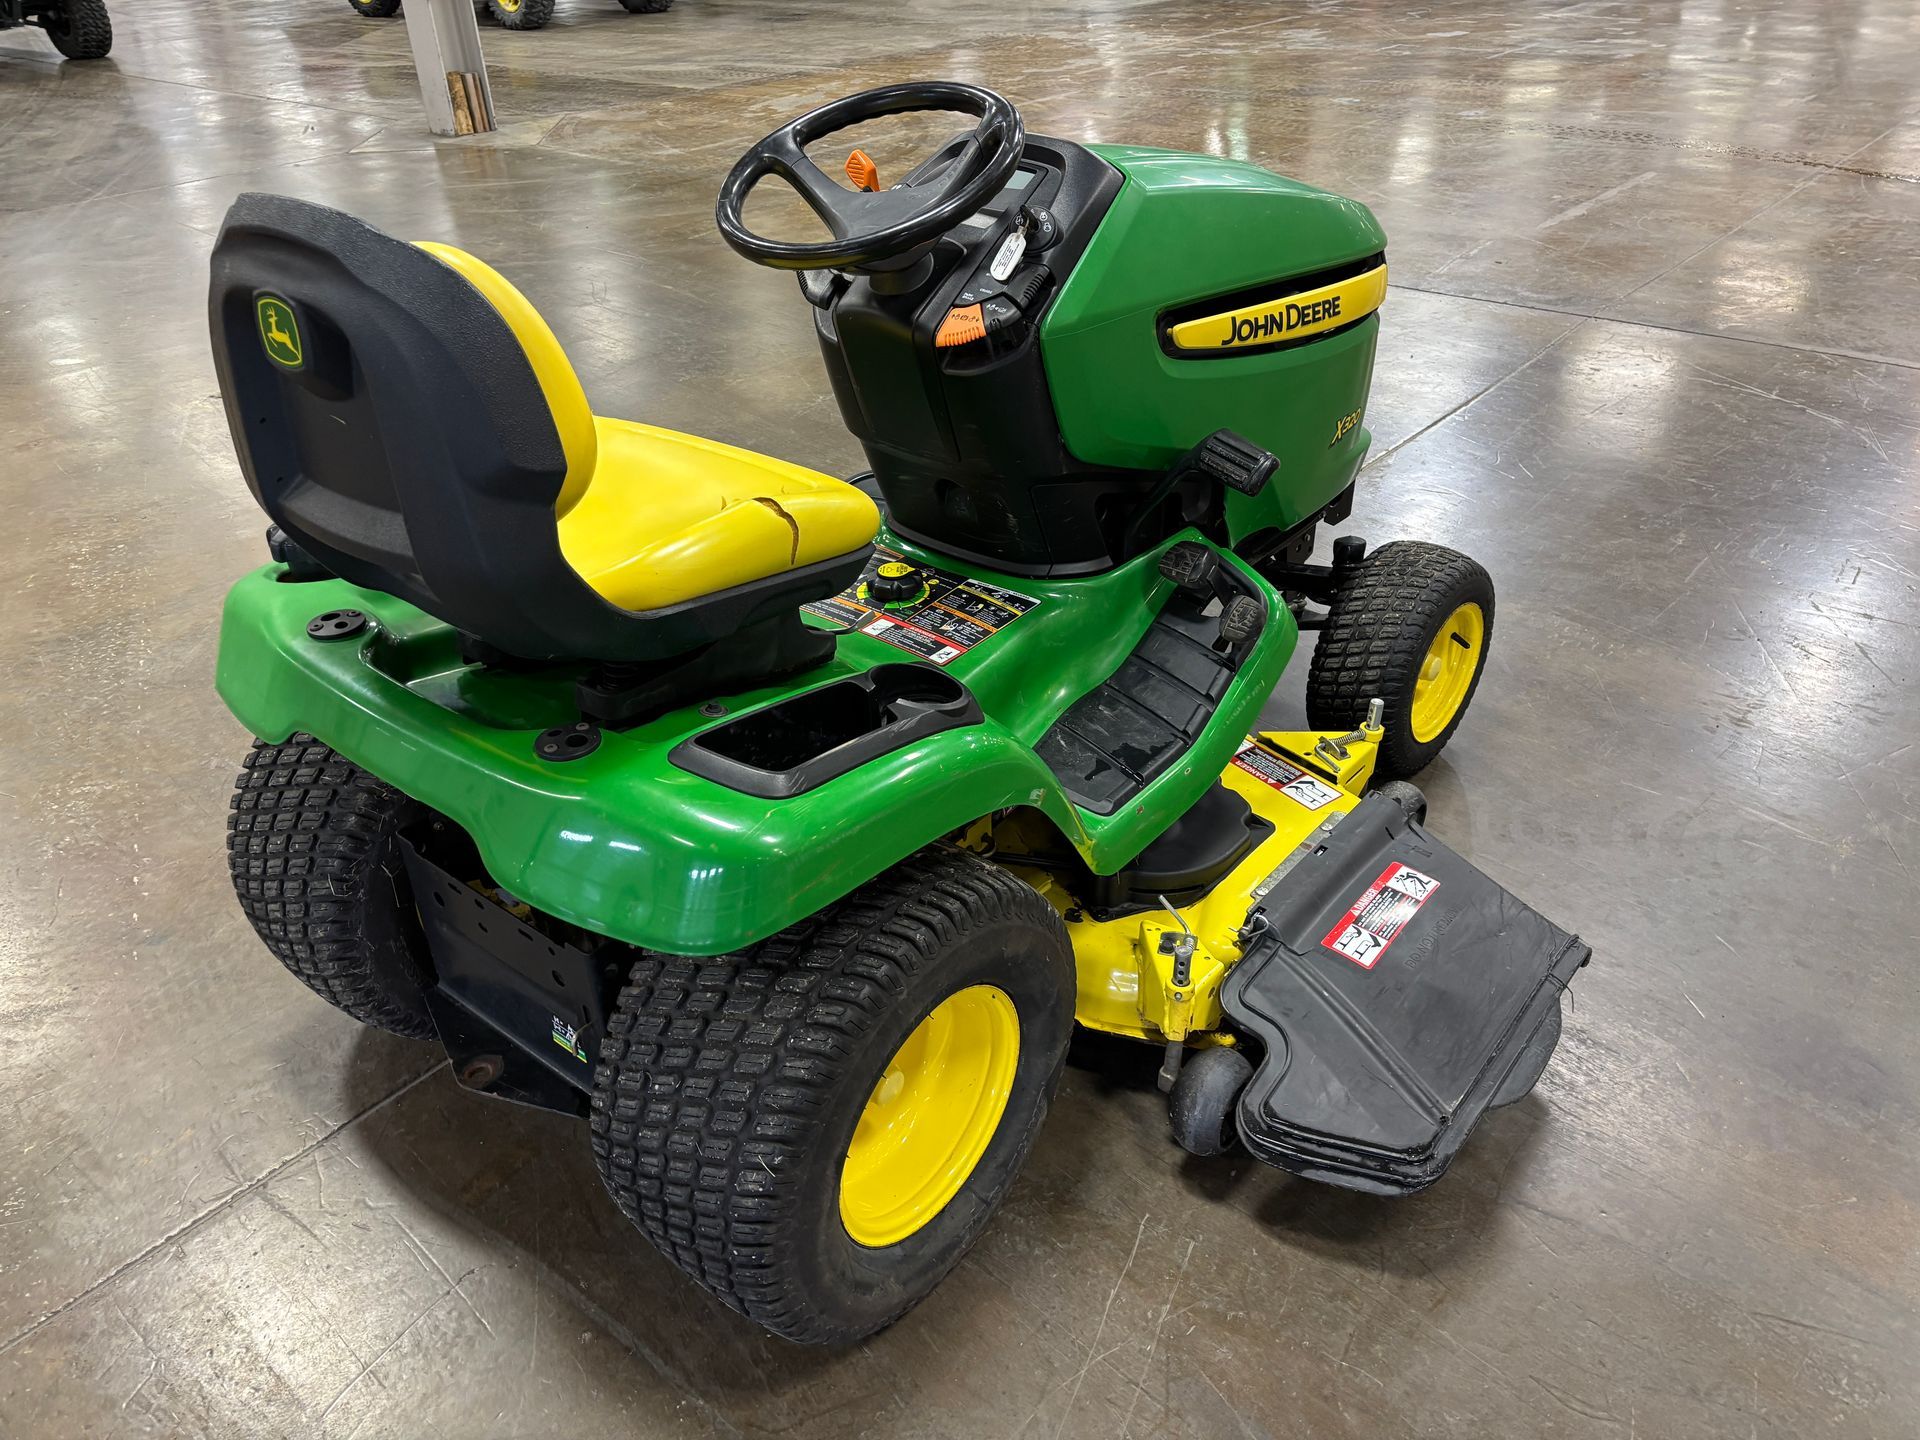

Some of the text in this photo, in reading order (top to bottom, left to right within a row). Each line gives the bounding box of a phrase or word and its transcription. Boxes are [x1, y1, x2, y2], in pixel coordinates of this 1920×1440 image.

[1221, 296, 1341, 345] JOHN DEERE
[1329, 407, 1361, 447] X320
[1235, 760, 1268, 780] DANGER
[1353, 888, 1379, 911] DANGER
[1404, 952, 1421, 969] DO
[1416, 929, 1438, 954] NOT
